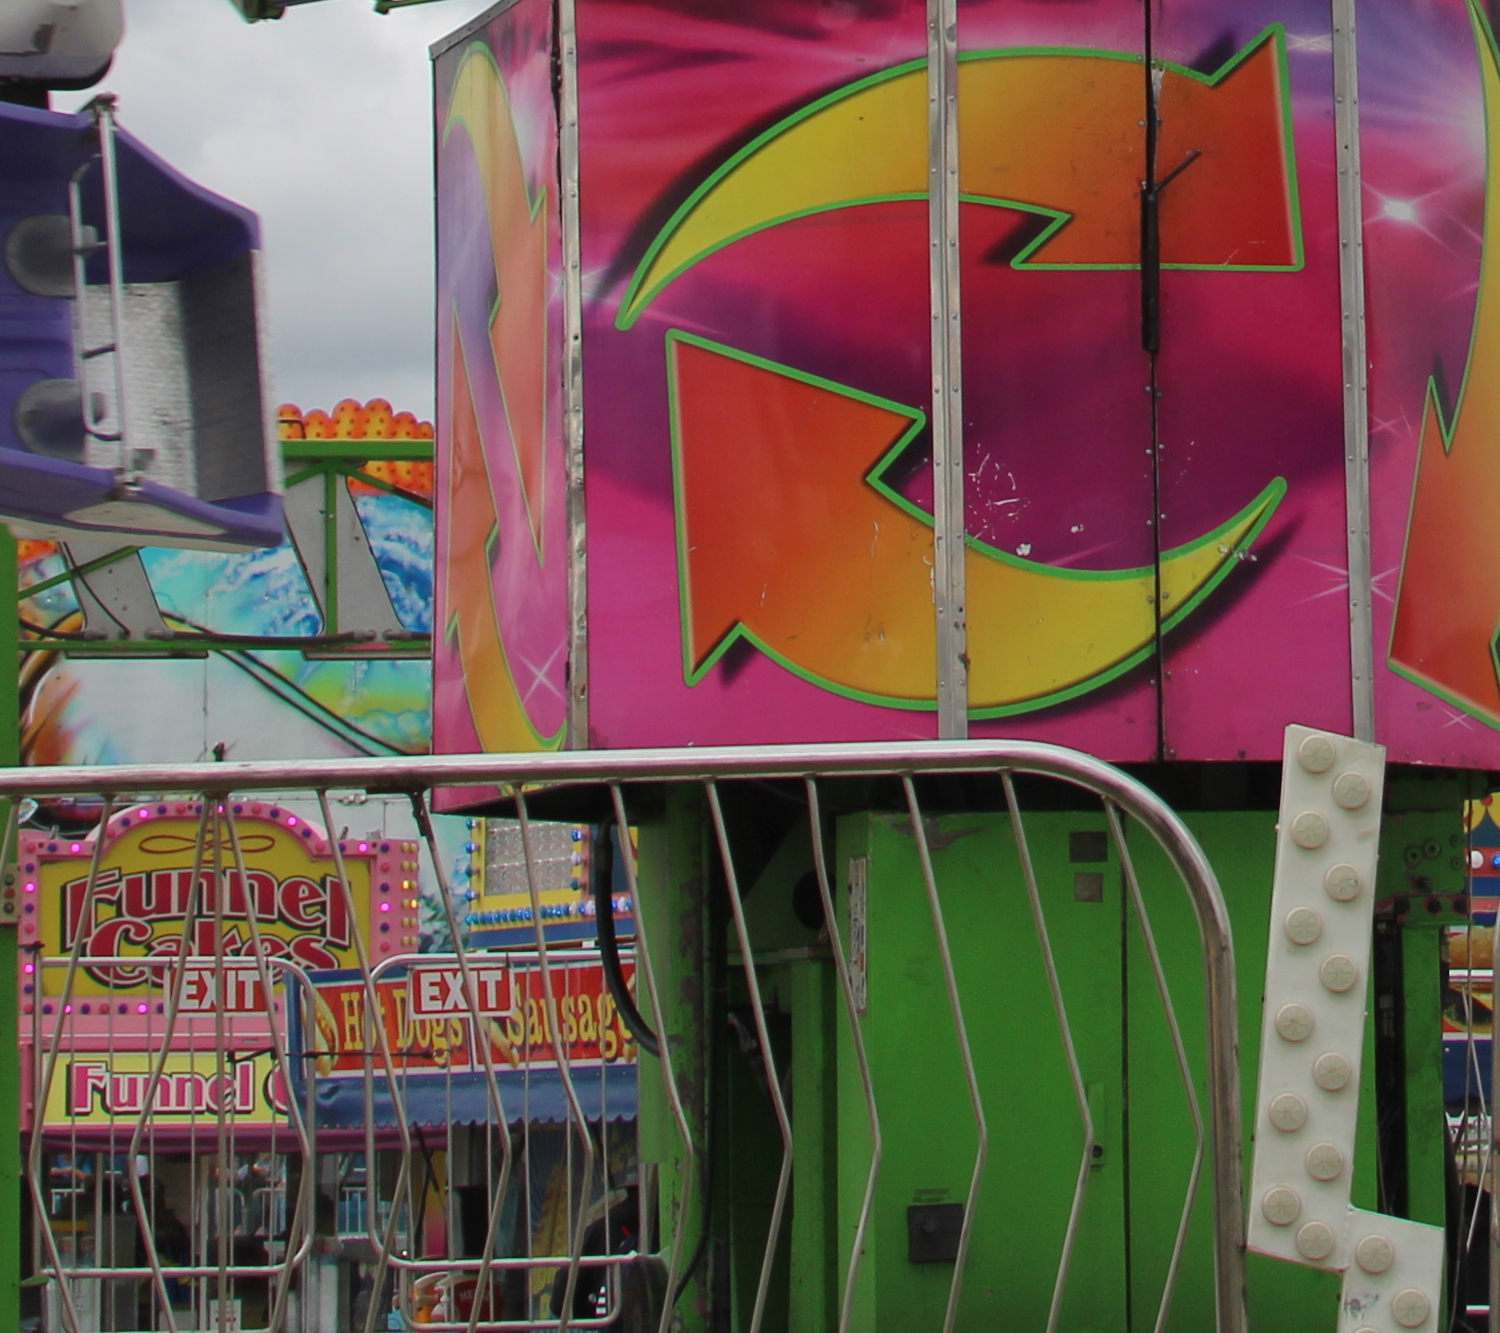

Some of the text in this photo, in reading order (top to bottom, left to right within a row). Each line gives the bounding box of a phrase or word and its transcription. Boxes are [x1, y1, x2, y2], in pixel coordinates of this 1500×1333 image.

[61, 866, 351, 953] Funnel
[179, 969, 264, 1011] EXIT
[419, 969, 502, 1012] EXIT
[65, 1060, 258, 1117] Funnel
